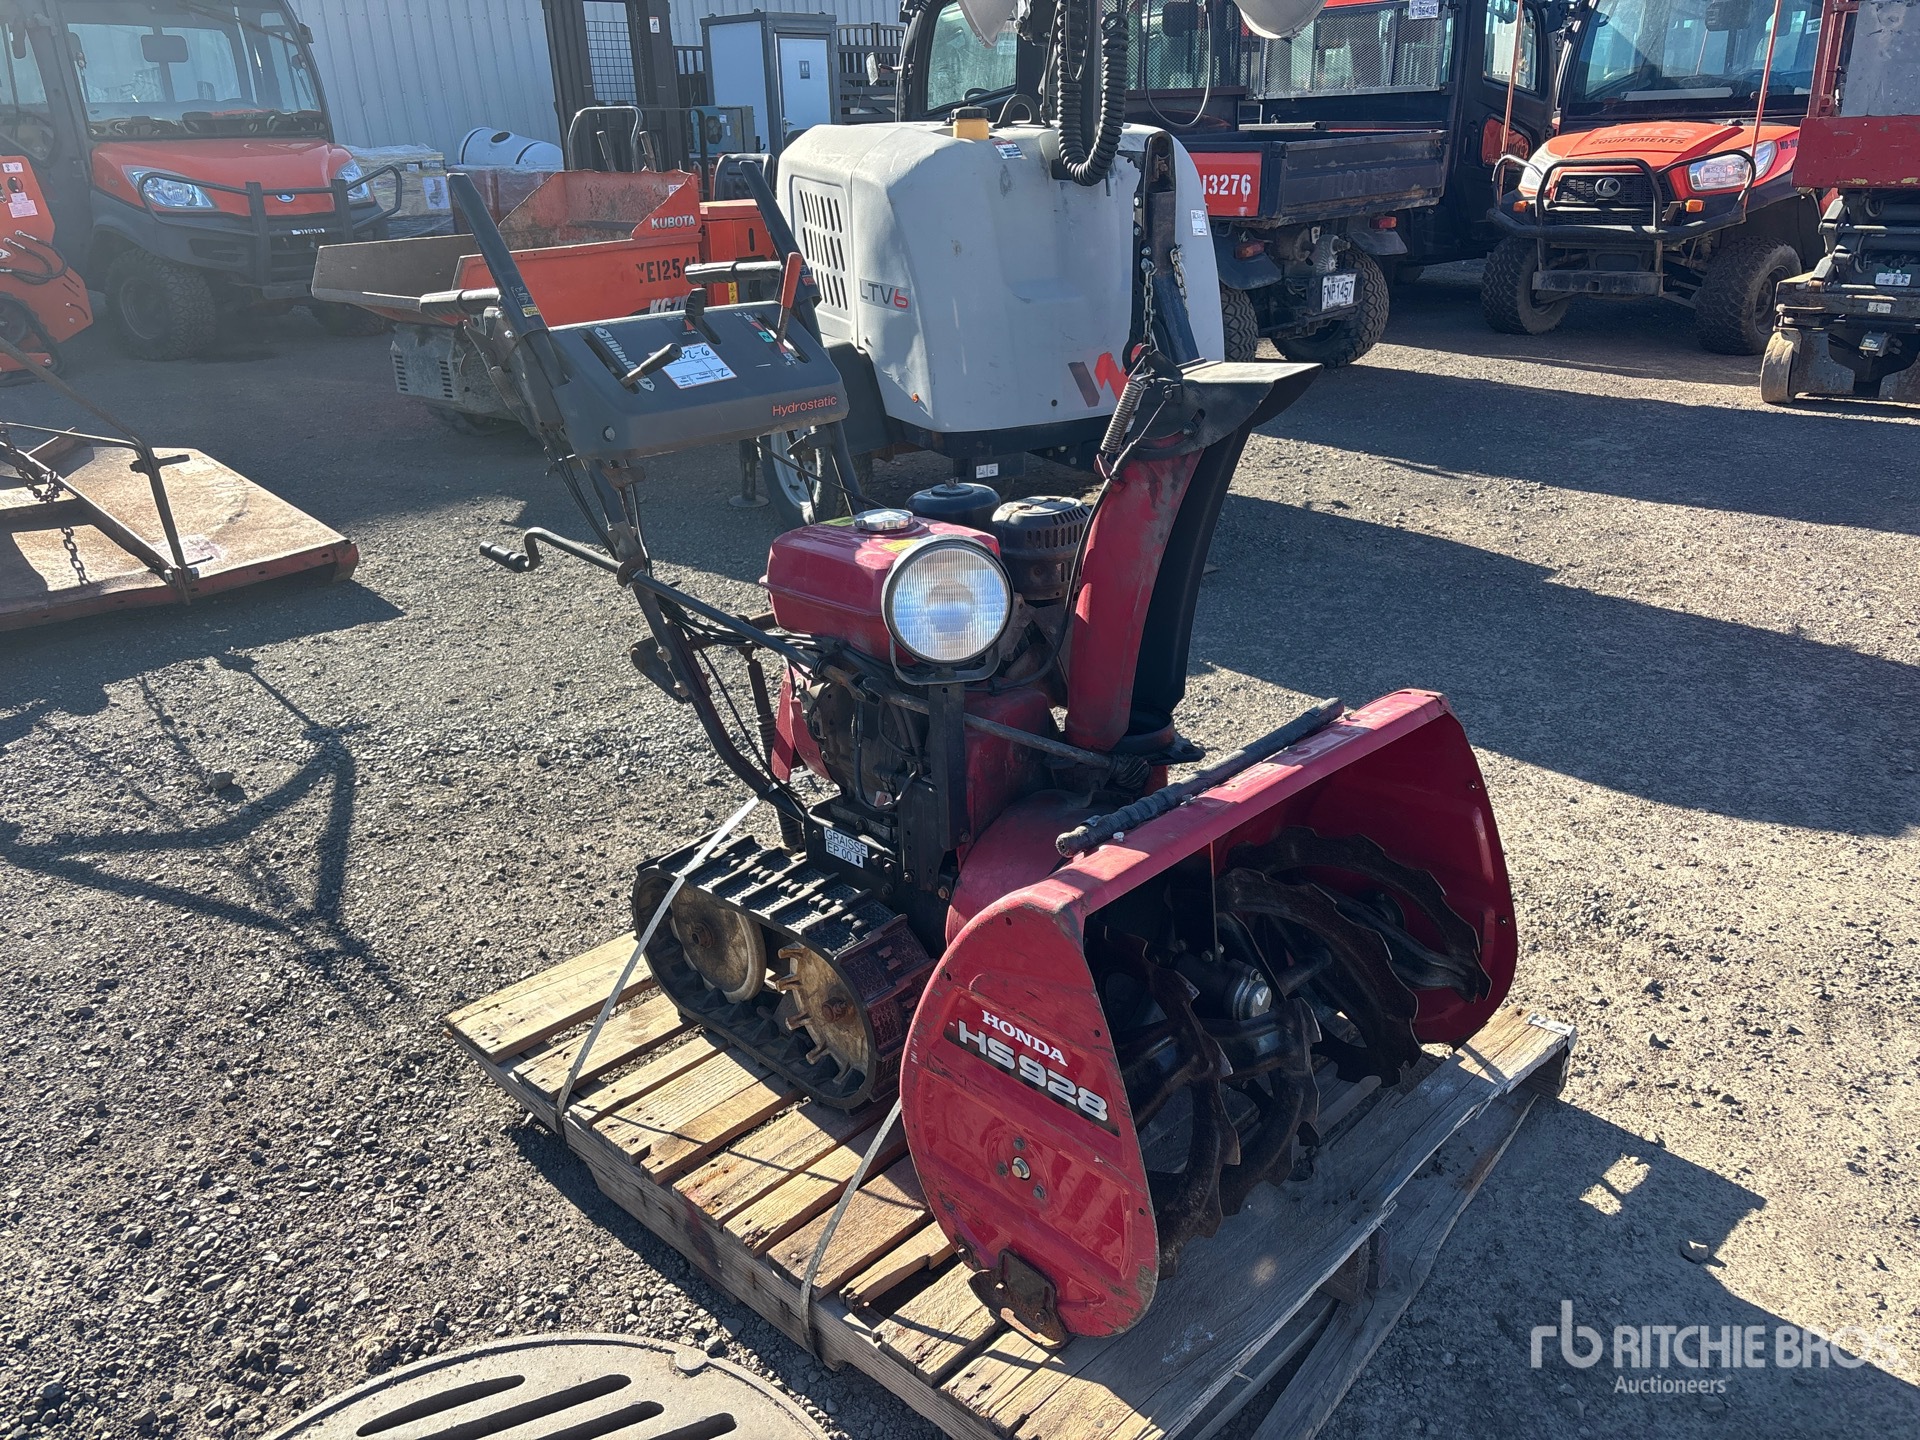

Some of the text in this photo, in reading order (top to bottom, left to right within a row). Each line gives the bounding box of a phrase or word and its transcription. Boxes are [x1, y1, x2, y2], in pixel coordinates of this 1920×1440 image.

[651, 215, 696, 230] KUBOTA
[860, 280, 910, 309] LTV6
[772, 396, 837, 417] Hydrostatic
[826, 829, 867, 857] GRAISSE
[827, 842, 839, 854] EP
[982, 1009, 1069, 1067] HONDA
[958, 1019, 1109, 1121] HS928
